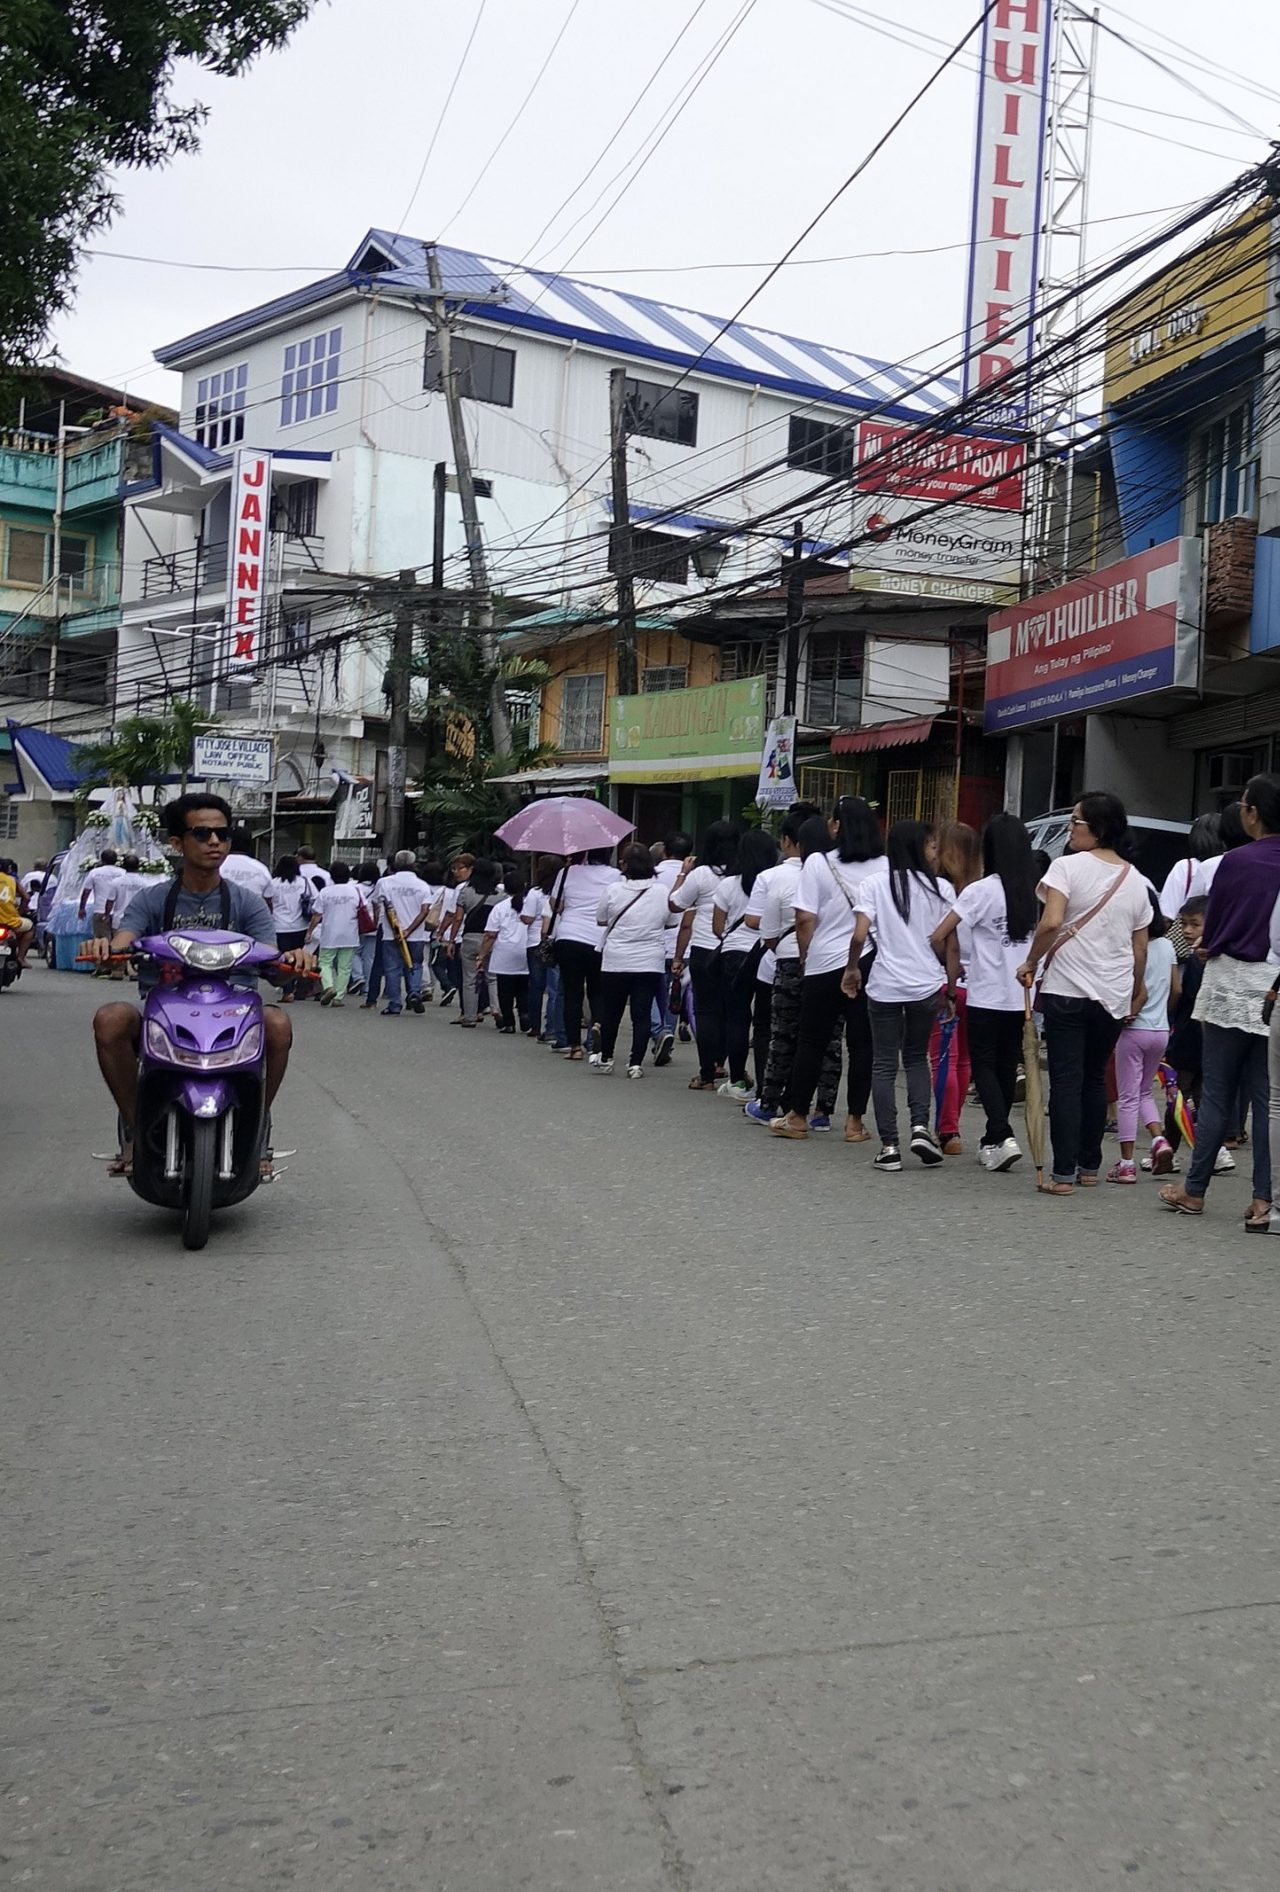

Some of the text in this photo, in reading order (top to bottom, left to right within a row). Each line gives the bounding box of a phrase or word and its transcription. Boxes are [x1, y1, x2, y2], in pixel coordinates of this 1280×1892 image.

[963, 445, 1022, 481] PADALA
[927, 480, 949, 491] your
[949, 482, 977, 494] mone
[896, 526, 1013, 554] MoneyGram
[234, 460, 265, 660] JANNEX
[895, 548, 932, 562] money
[880, 575, 994, 600] MONEY CHANGER
[1034, 643, 1112, 676] Ang Tulay ng Pilipino
[202, 759, 263, 770] NOTARY PUBLIC
[204, 750, 257, 762] LAW OFFICE
[355, 811, 373, 829] EW
